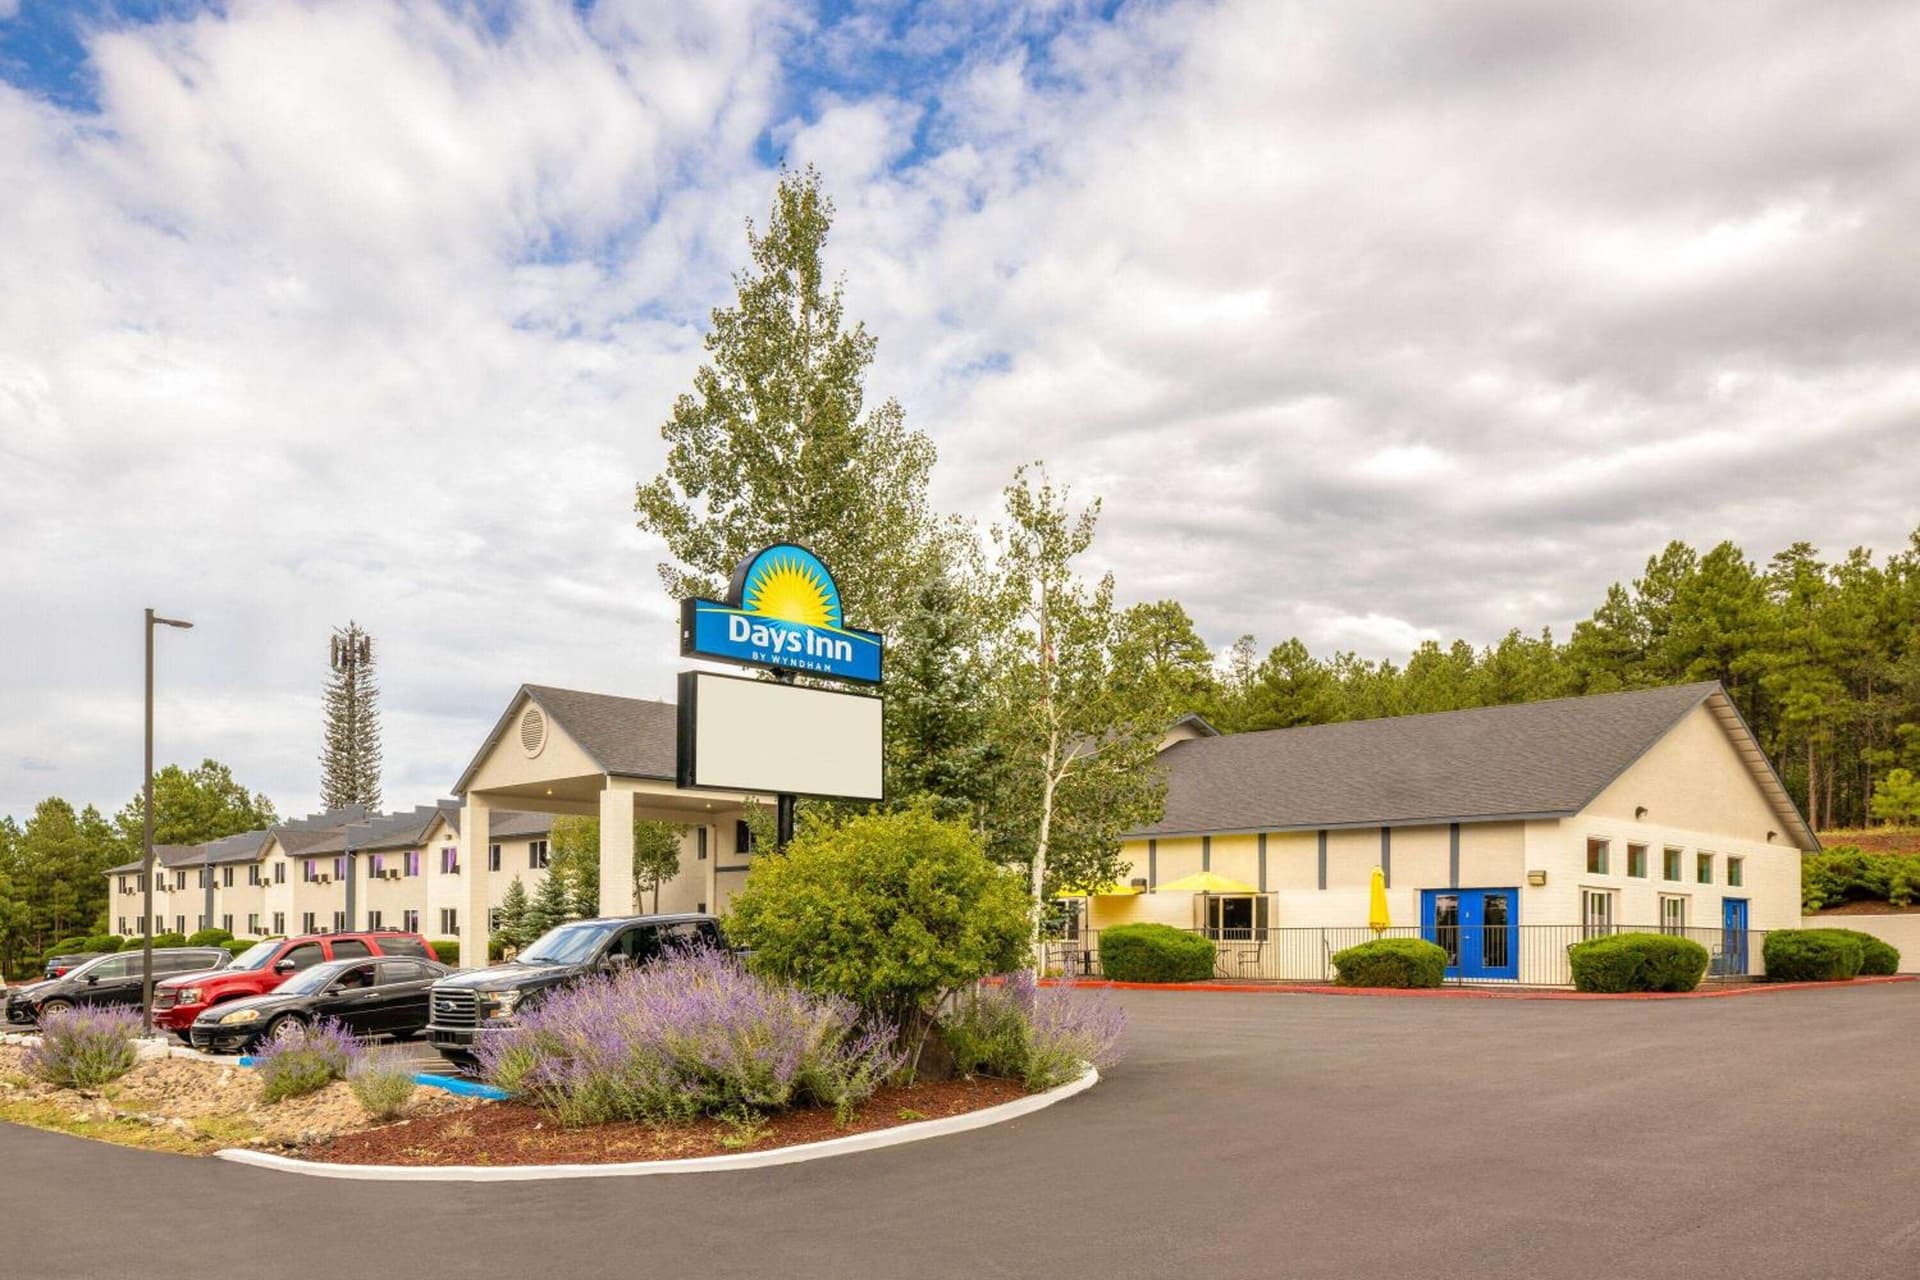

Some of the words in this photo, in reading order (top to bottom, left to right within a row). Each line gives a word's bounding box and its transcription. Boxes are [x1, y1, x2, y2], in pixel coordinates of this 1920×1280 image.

[729, 615, 801, 653] Days
[806, 629, 853, 662] Inn
[751, 651, 766, 661] BY
[771, 655, 832, 672] WYNDHAM
